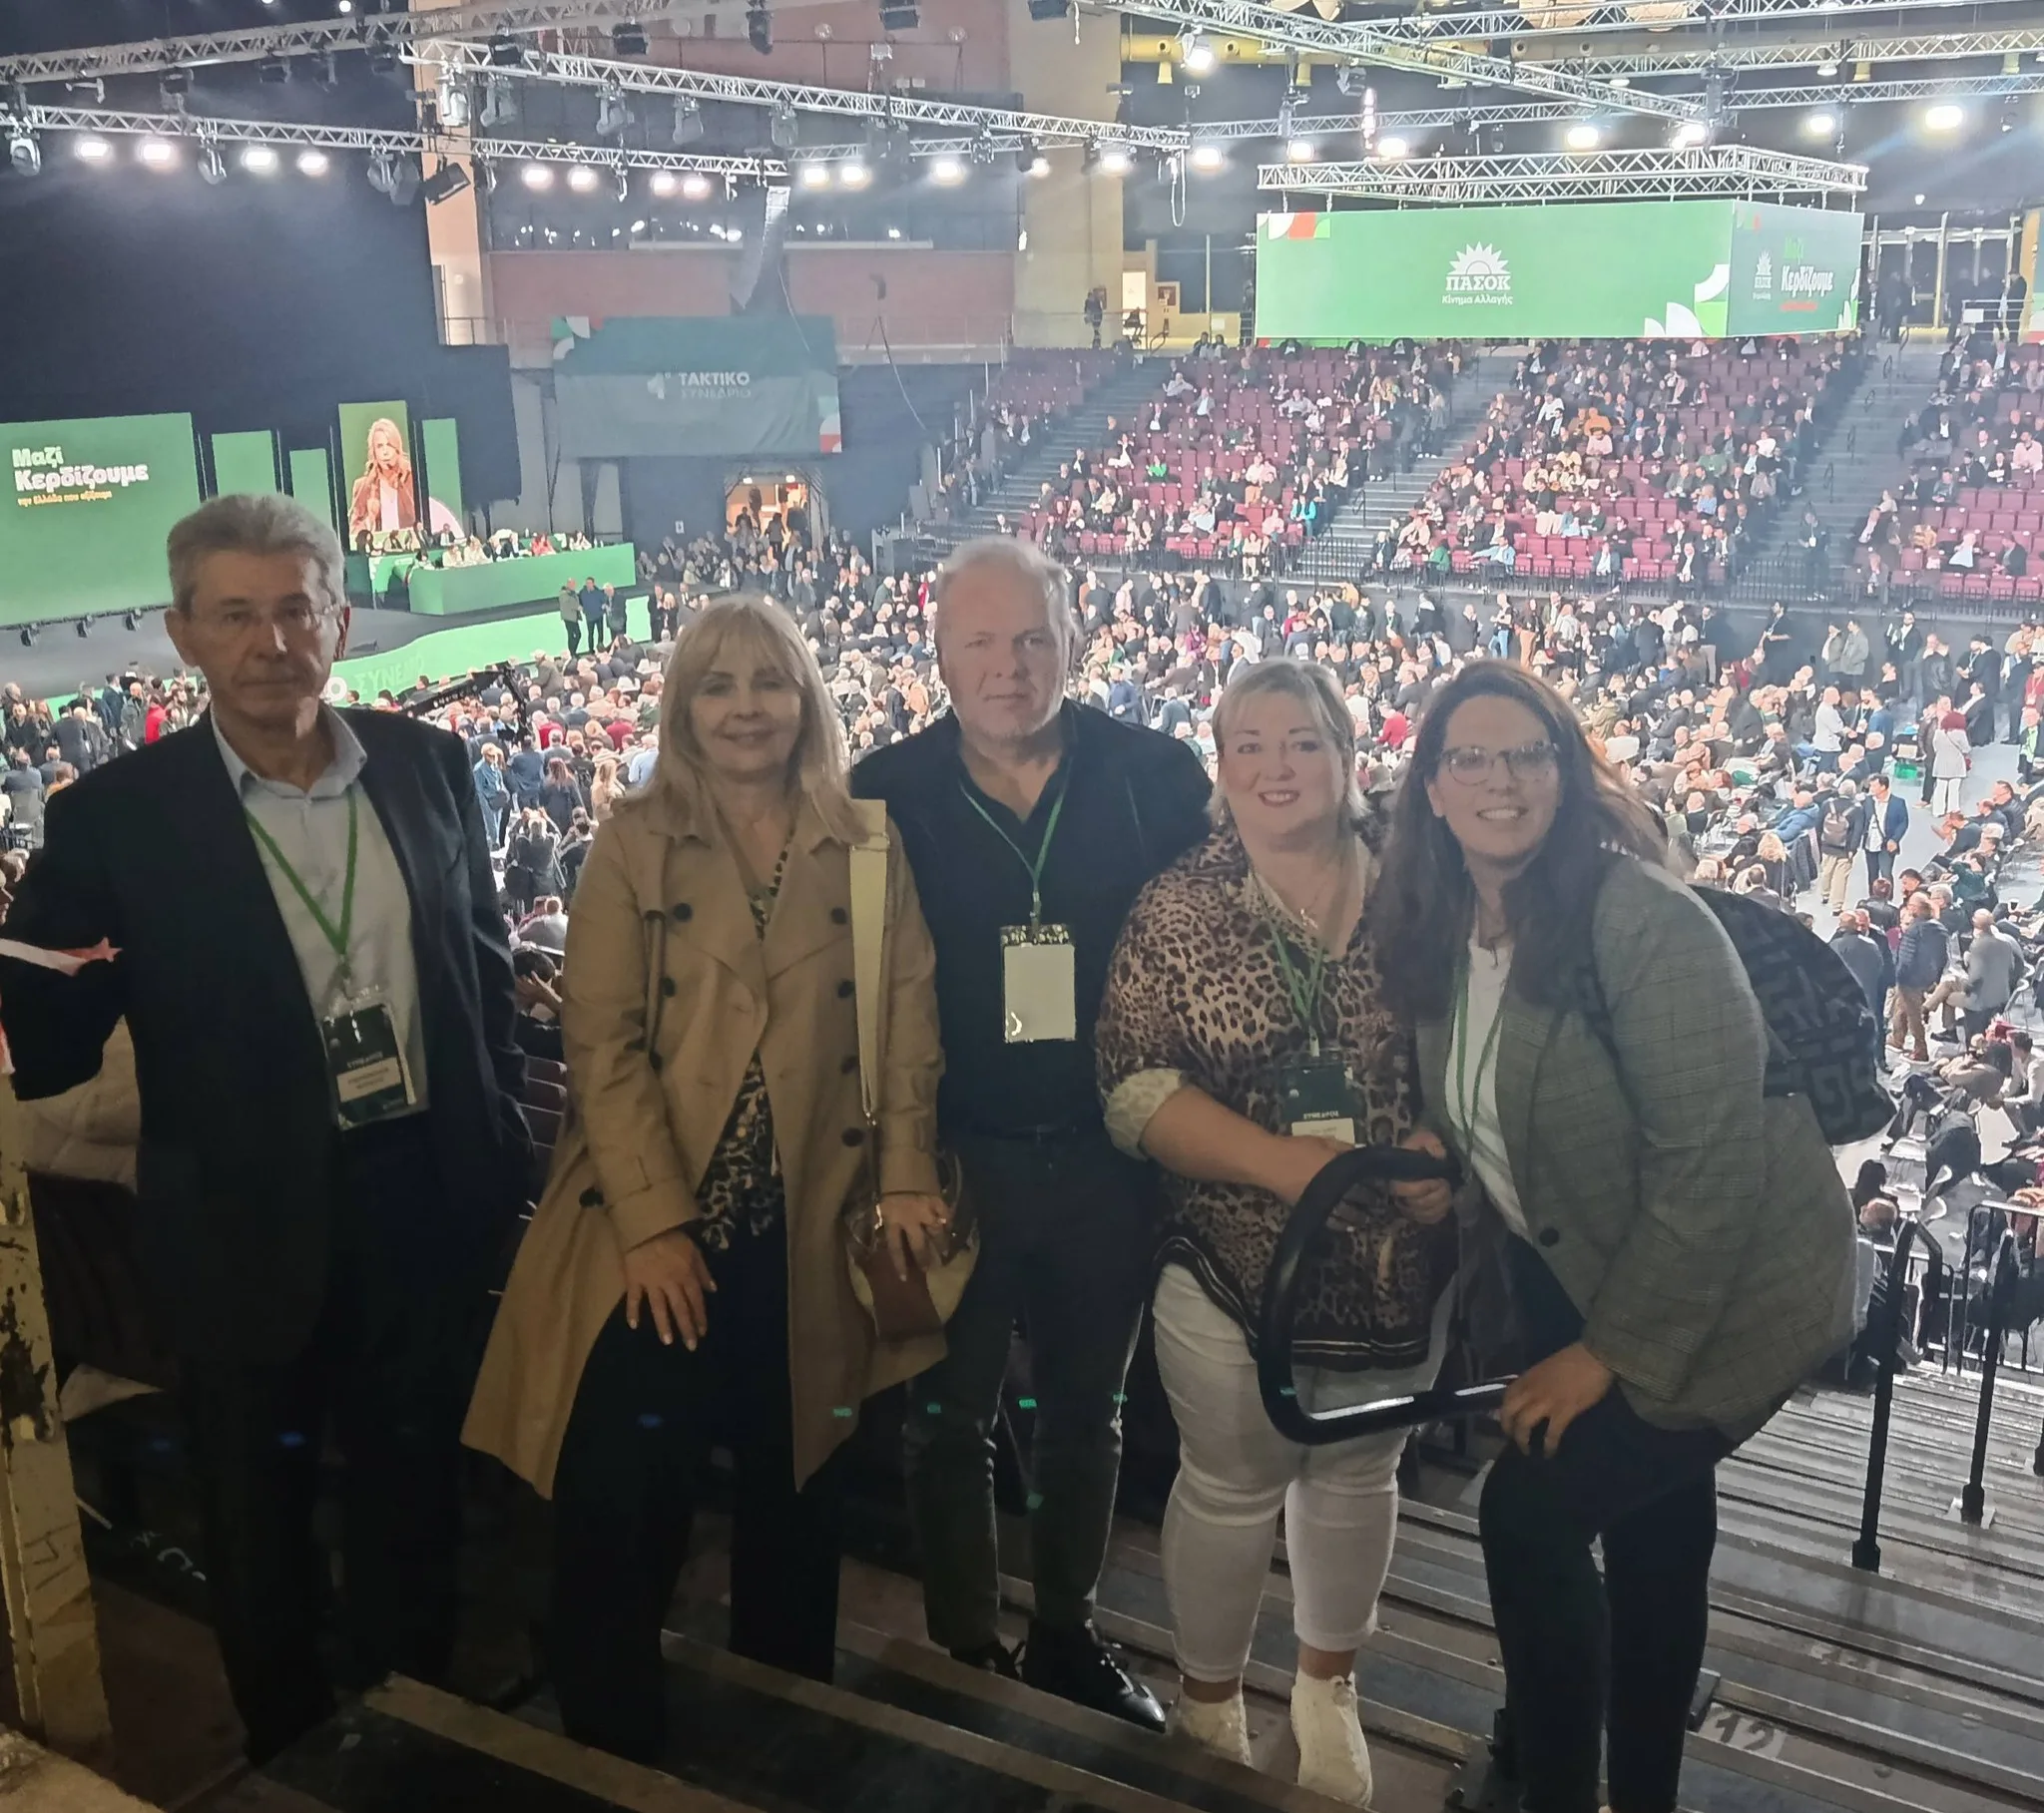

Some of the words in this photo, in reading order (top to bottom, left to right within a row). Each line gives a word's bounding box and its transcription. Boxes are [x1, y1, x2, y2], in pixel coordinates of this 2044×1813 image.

[1445, 275, 1511, 291] ΠΑΣΟΚ
[1441, 293, 1473, 306] Κίνημα
[1473, 292, 1514, 306] Αλλαγής
[12, 446, 64, 468] Μαζί
[14, 464, 150, 493] Κερδίζουμε
[1715, 1712, 1776, 1753] 12
